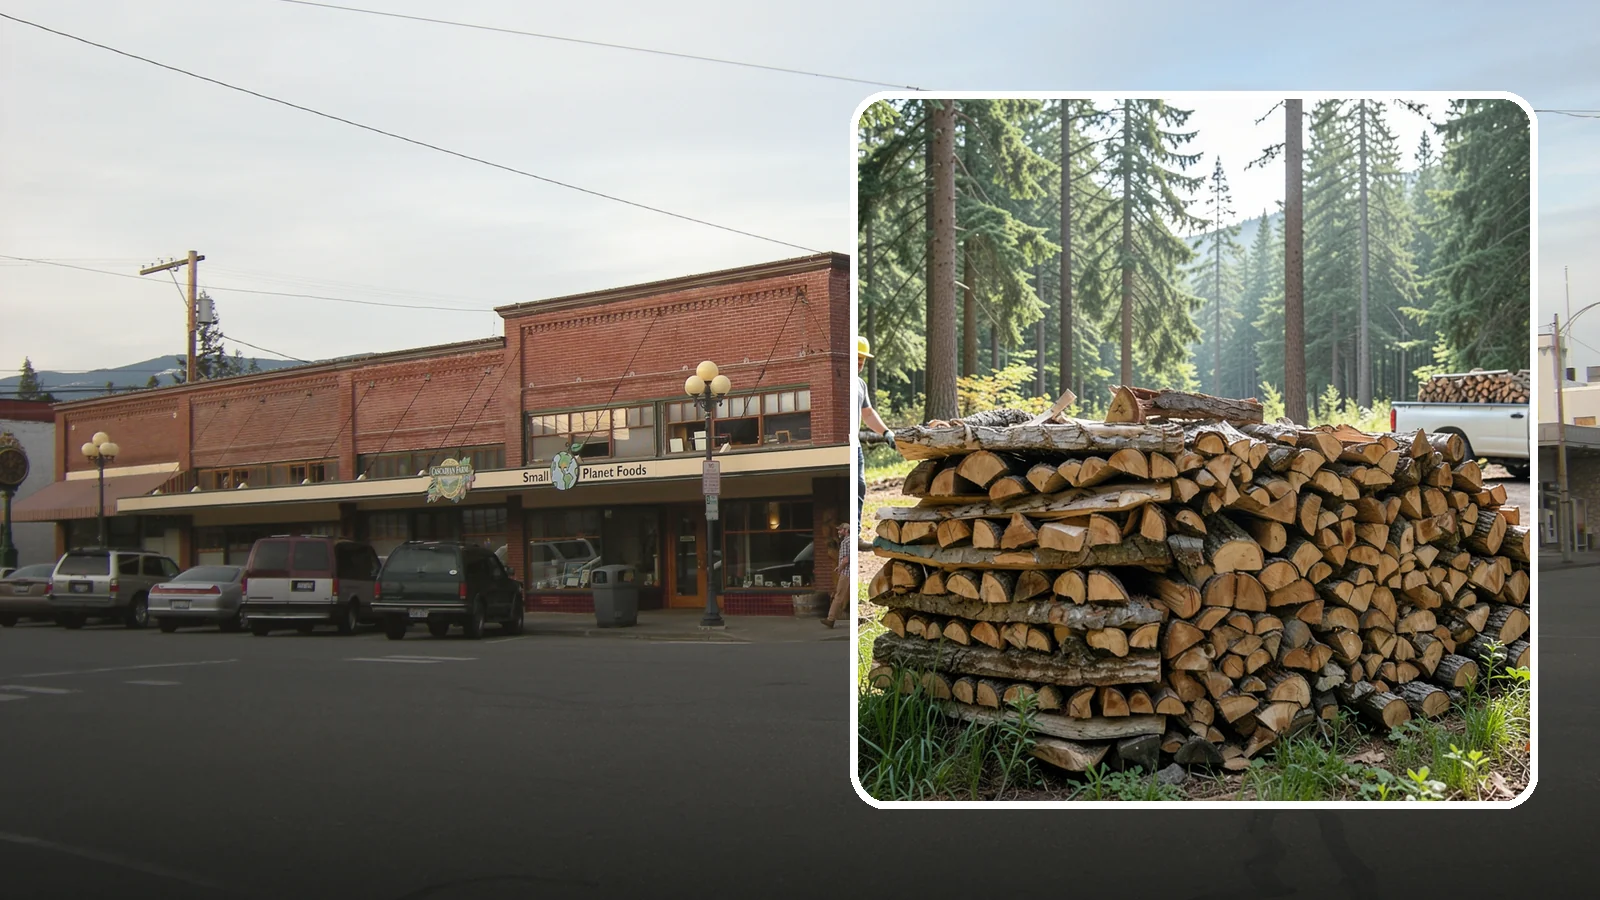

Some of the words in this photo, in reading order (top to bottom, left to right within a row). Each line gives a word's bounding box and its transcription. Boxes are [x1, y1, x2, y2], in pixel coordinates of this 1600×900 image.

[523, 471, 549, 483] Small
[583, 467, 614, 479] Planet
[617, 464, 647, 477] Foods
